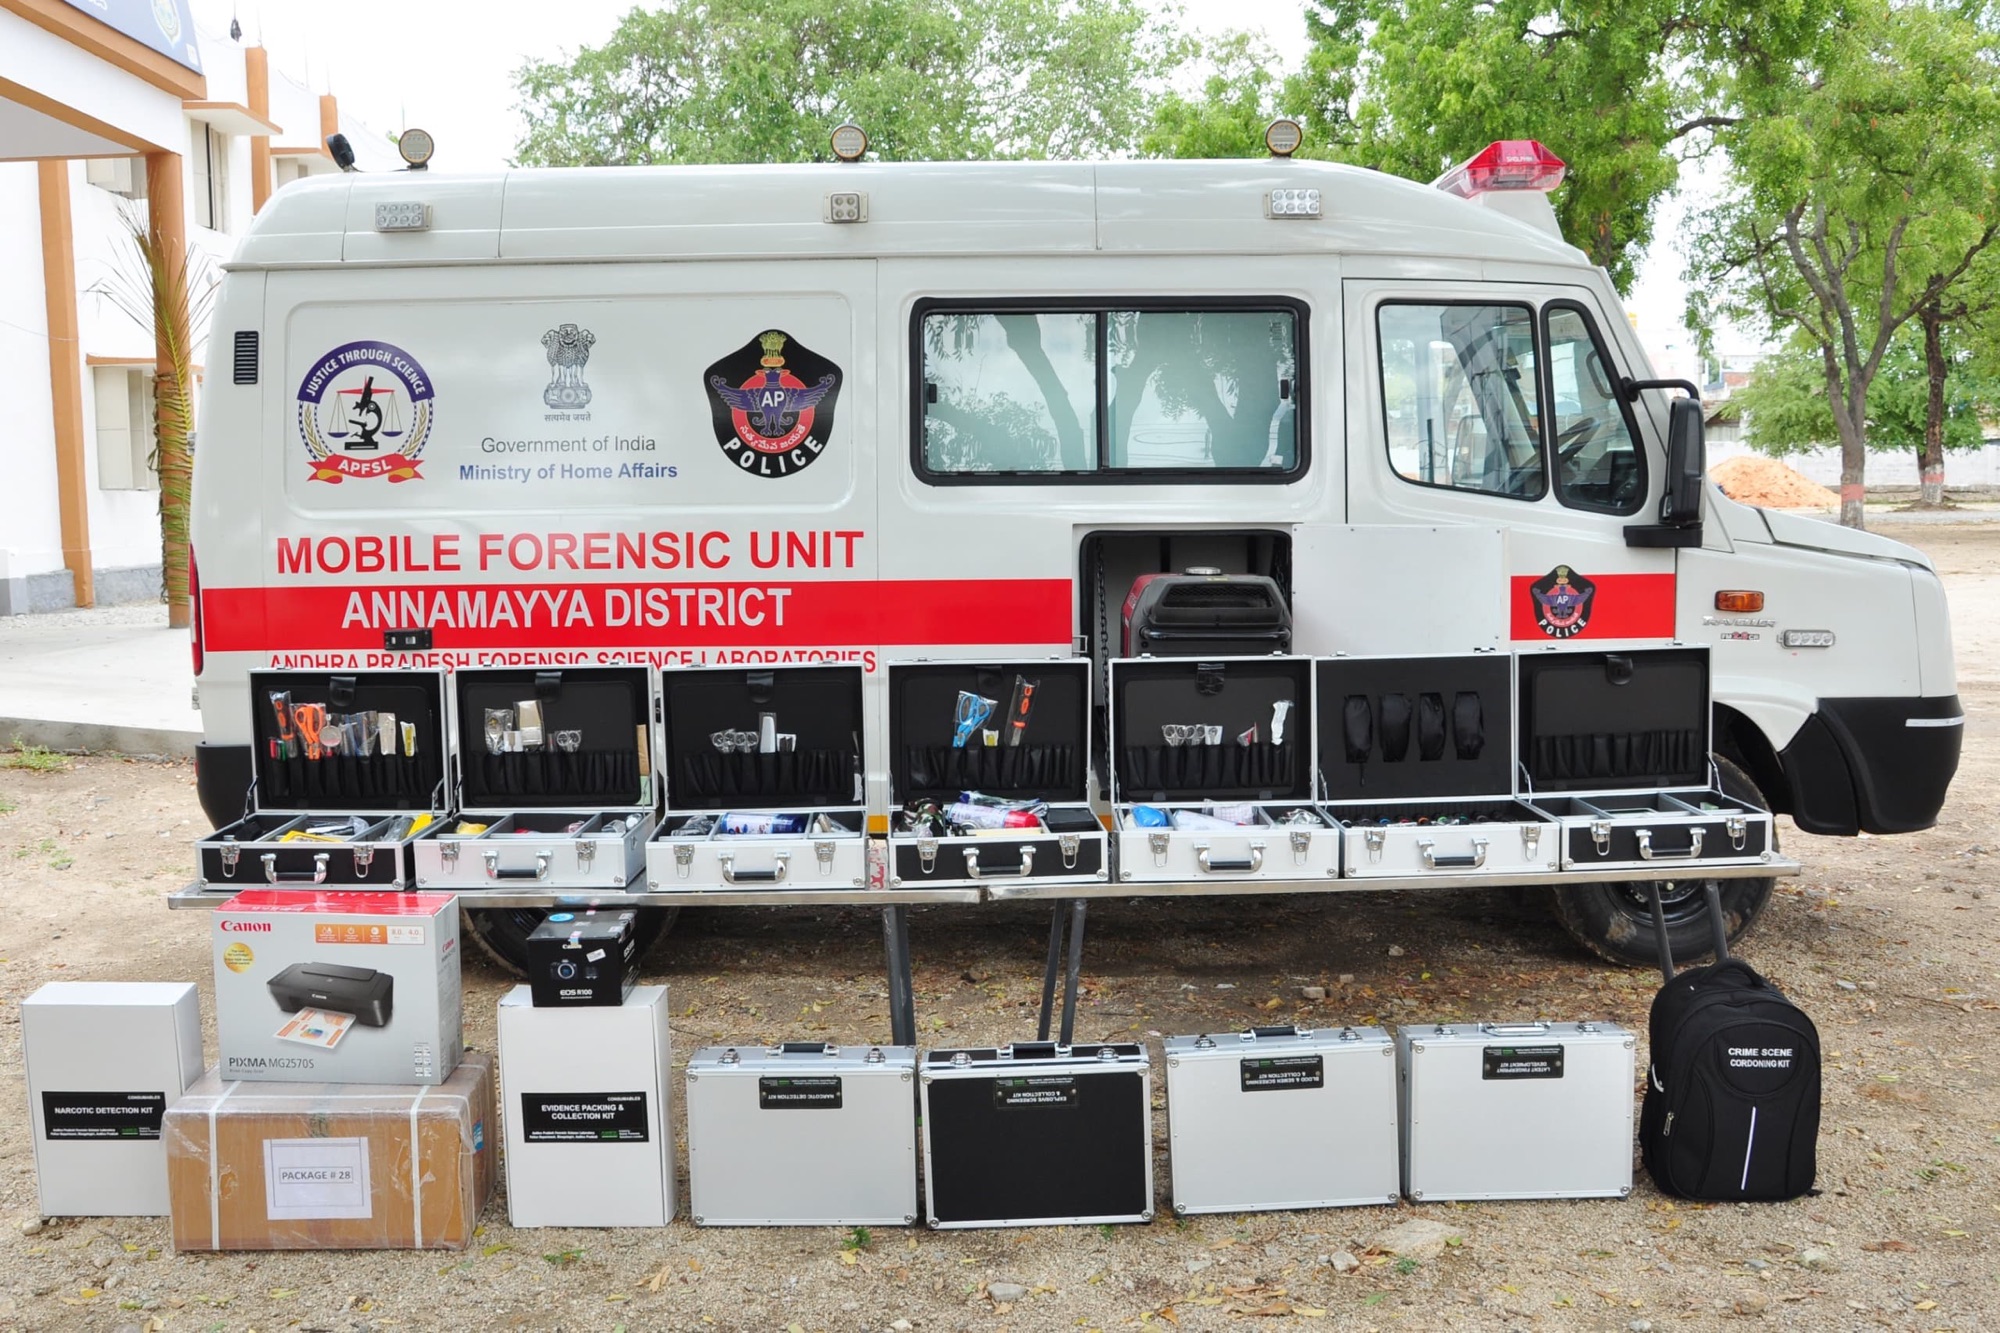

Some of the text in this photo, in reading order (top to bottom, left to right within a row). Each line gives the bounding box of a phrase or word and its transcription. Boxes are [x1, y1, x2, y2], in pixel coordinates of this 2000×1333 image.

[306, 349, 426, 397] JUSTICE THROUGH SCIENCE
[761, 391, 785, 408] AP
[481, 435, 656, 453] Government of India
[723, 436, 823, 474] POLICE
[338, 459, 392, 475] APFSL
[459, 462, 678, 484] Ministry of Home Affairs
[277, 530, 864, 574] MOBILE FORENSIC UNIT
[1557, 595, 1569, 604] AP
[341, 587, 792, 629] ANNAMAYYA DISTRICT
[1538, 618, 1587, 638] POLICE
[220, 920, 272, 932] Canon
[1728, 1047, 1793, 1057] CRIME SCENE
[229, 1057, 314, 1069] PIXMA MG2570S
[1730, 1058, 1791, 1068] CORDONING KIT
[54, 1106, 94, 1114] NARCOTIC
[141, 1106, 153, 1114] KIT
[541, 1104, 579, 1112] EVIDENCE
[551, 1112, 601, 1120] COLLECTION
[282, 1171, 328, 1180] PACKAGE
[338, 1170, 351, 1180] 28
